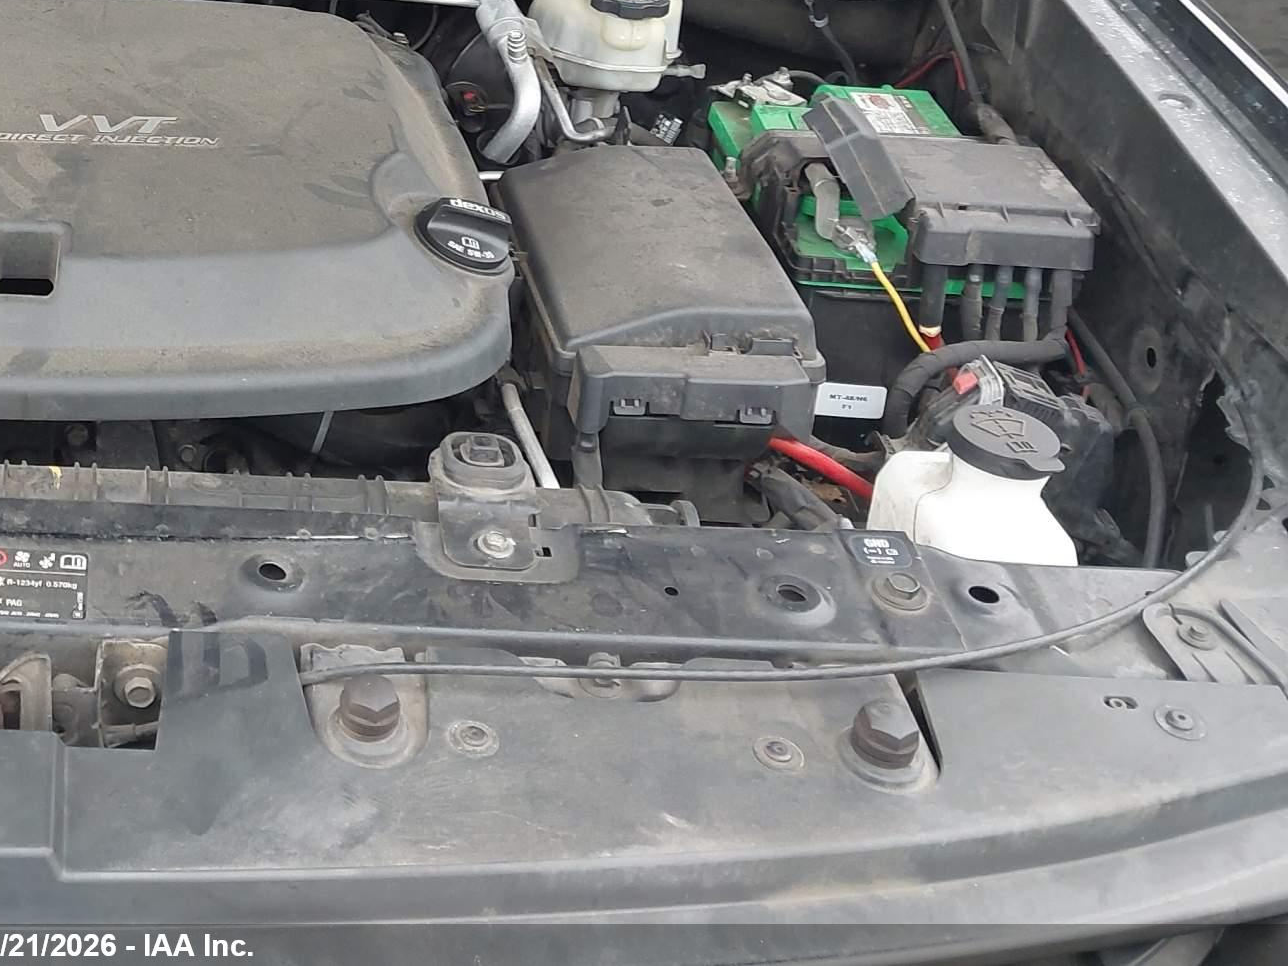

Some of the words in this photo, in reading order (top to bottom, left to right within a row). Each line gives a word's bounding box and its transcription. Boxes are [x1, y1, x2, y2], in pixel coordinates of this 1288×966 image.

[39, 114, 178, 133] VVT
[91, 134, 220, 147] INJECTION
[450, 199, 506, 220] dexos
